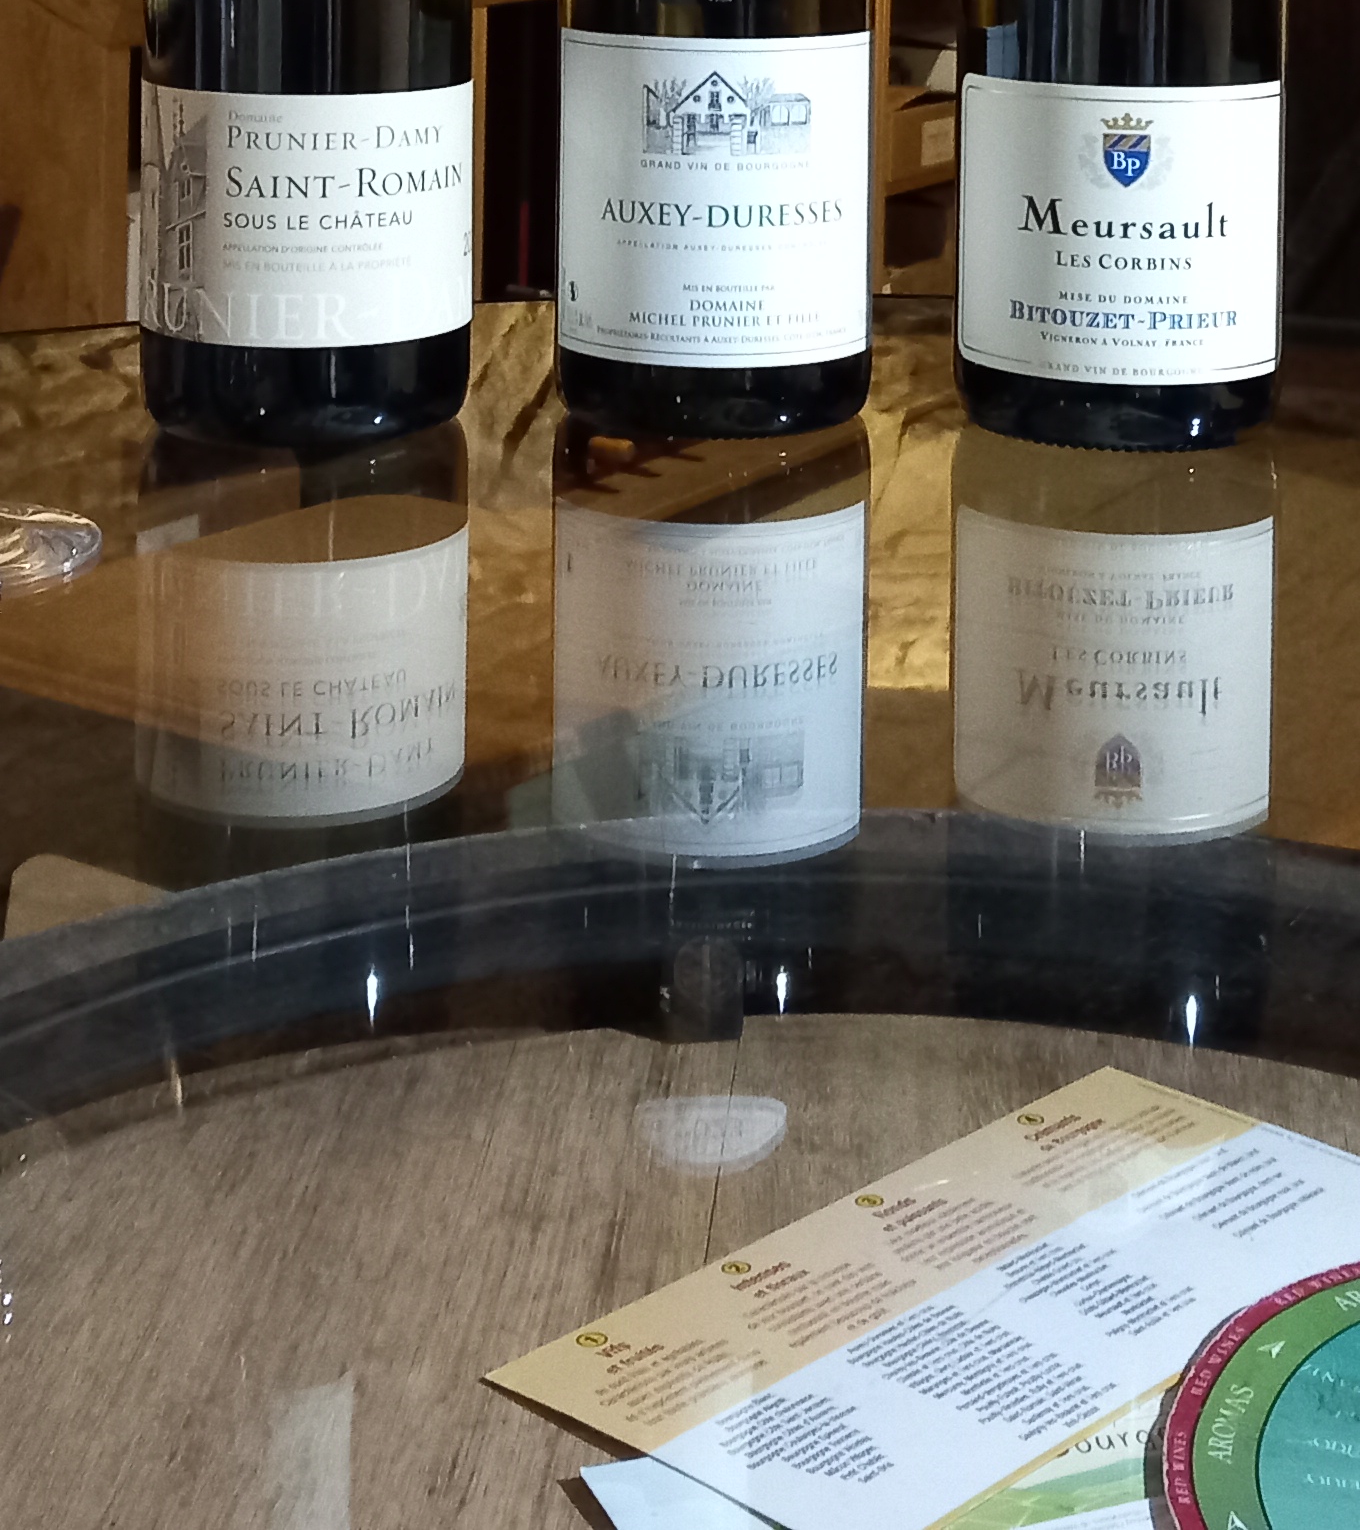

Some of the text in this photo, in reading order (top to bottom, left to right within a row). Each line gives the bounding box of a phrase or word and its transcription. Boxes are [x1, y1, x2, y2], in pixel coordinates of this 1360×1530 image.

[227, 108, 284, 124] Domaine
[225, 124, 443, 152] PRUNIER-DAMY
[640, 159, 681, 171] GRAND
[687, 160, 709, 171] VIN
[714, 160, 730, 172] DE
[224, 162, 464, 200] SAINT-ROMAIN
[223, 208, 414, 232] SOUS LE CHÂTEAU
[600, 197, 843, 229] AUXEY-DURESSES
[1017, 194, 1229, 241] Meursault
[222, 242, 279, 254] APPELLATION
[1055, 250, 1193, 272] LES CORBINS
[689, 298, 765, 312] DOMAINE
[1058, 290, 1190, 306] MISE DU DOMAINE
[628, 311, 687, 328] MICHEL
[691, 313, 761, 328] PRUNIER
[1009, 298, 1238, 330] BITOUZET-PRIEUR
[1207, 1383, 1255, 1465] AROMAS
